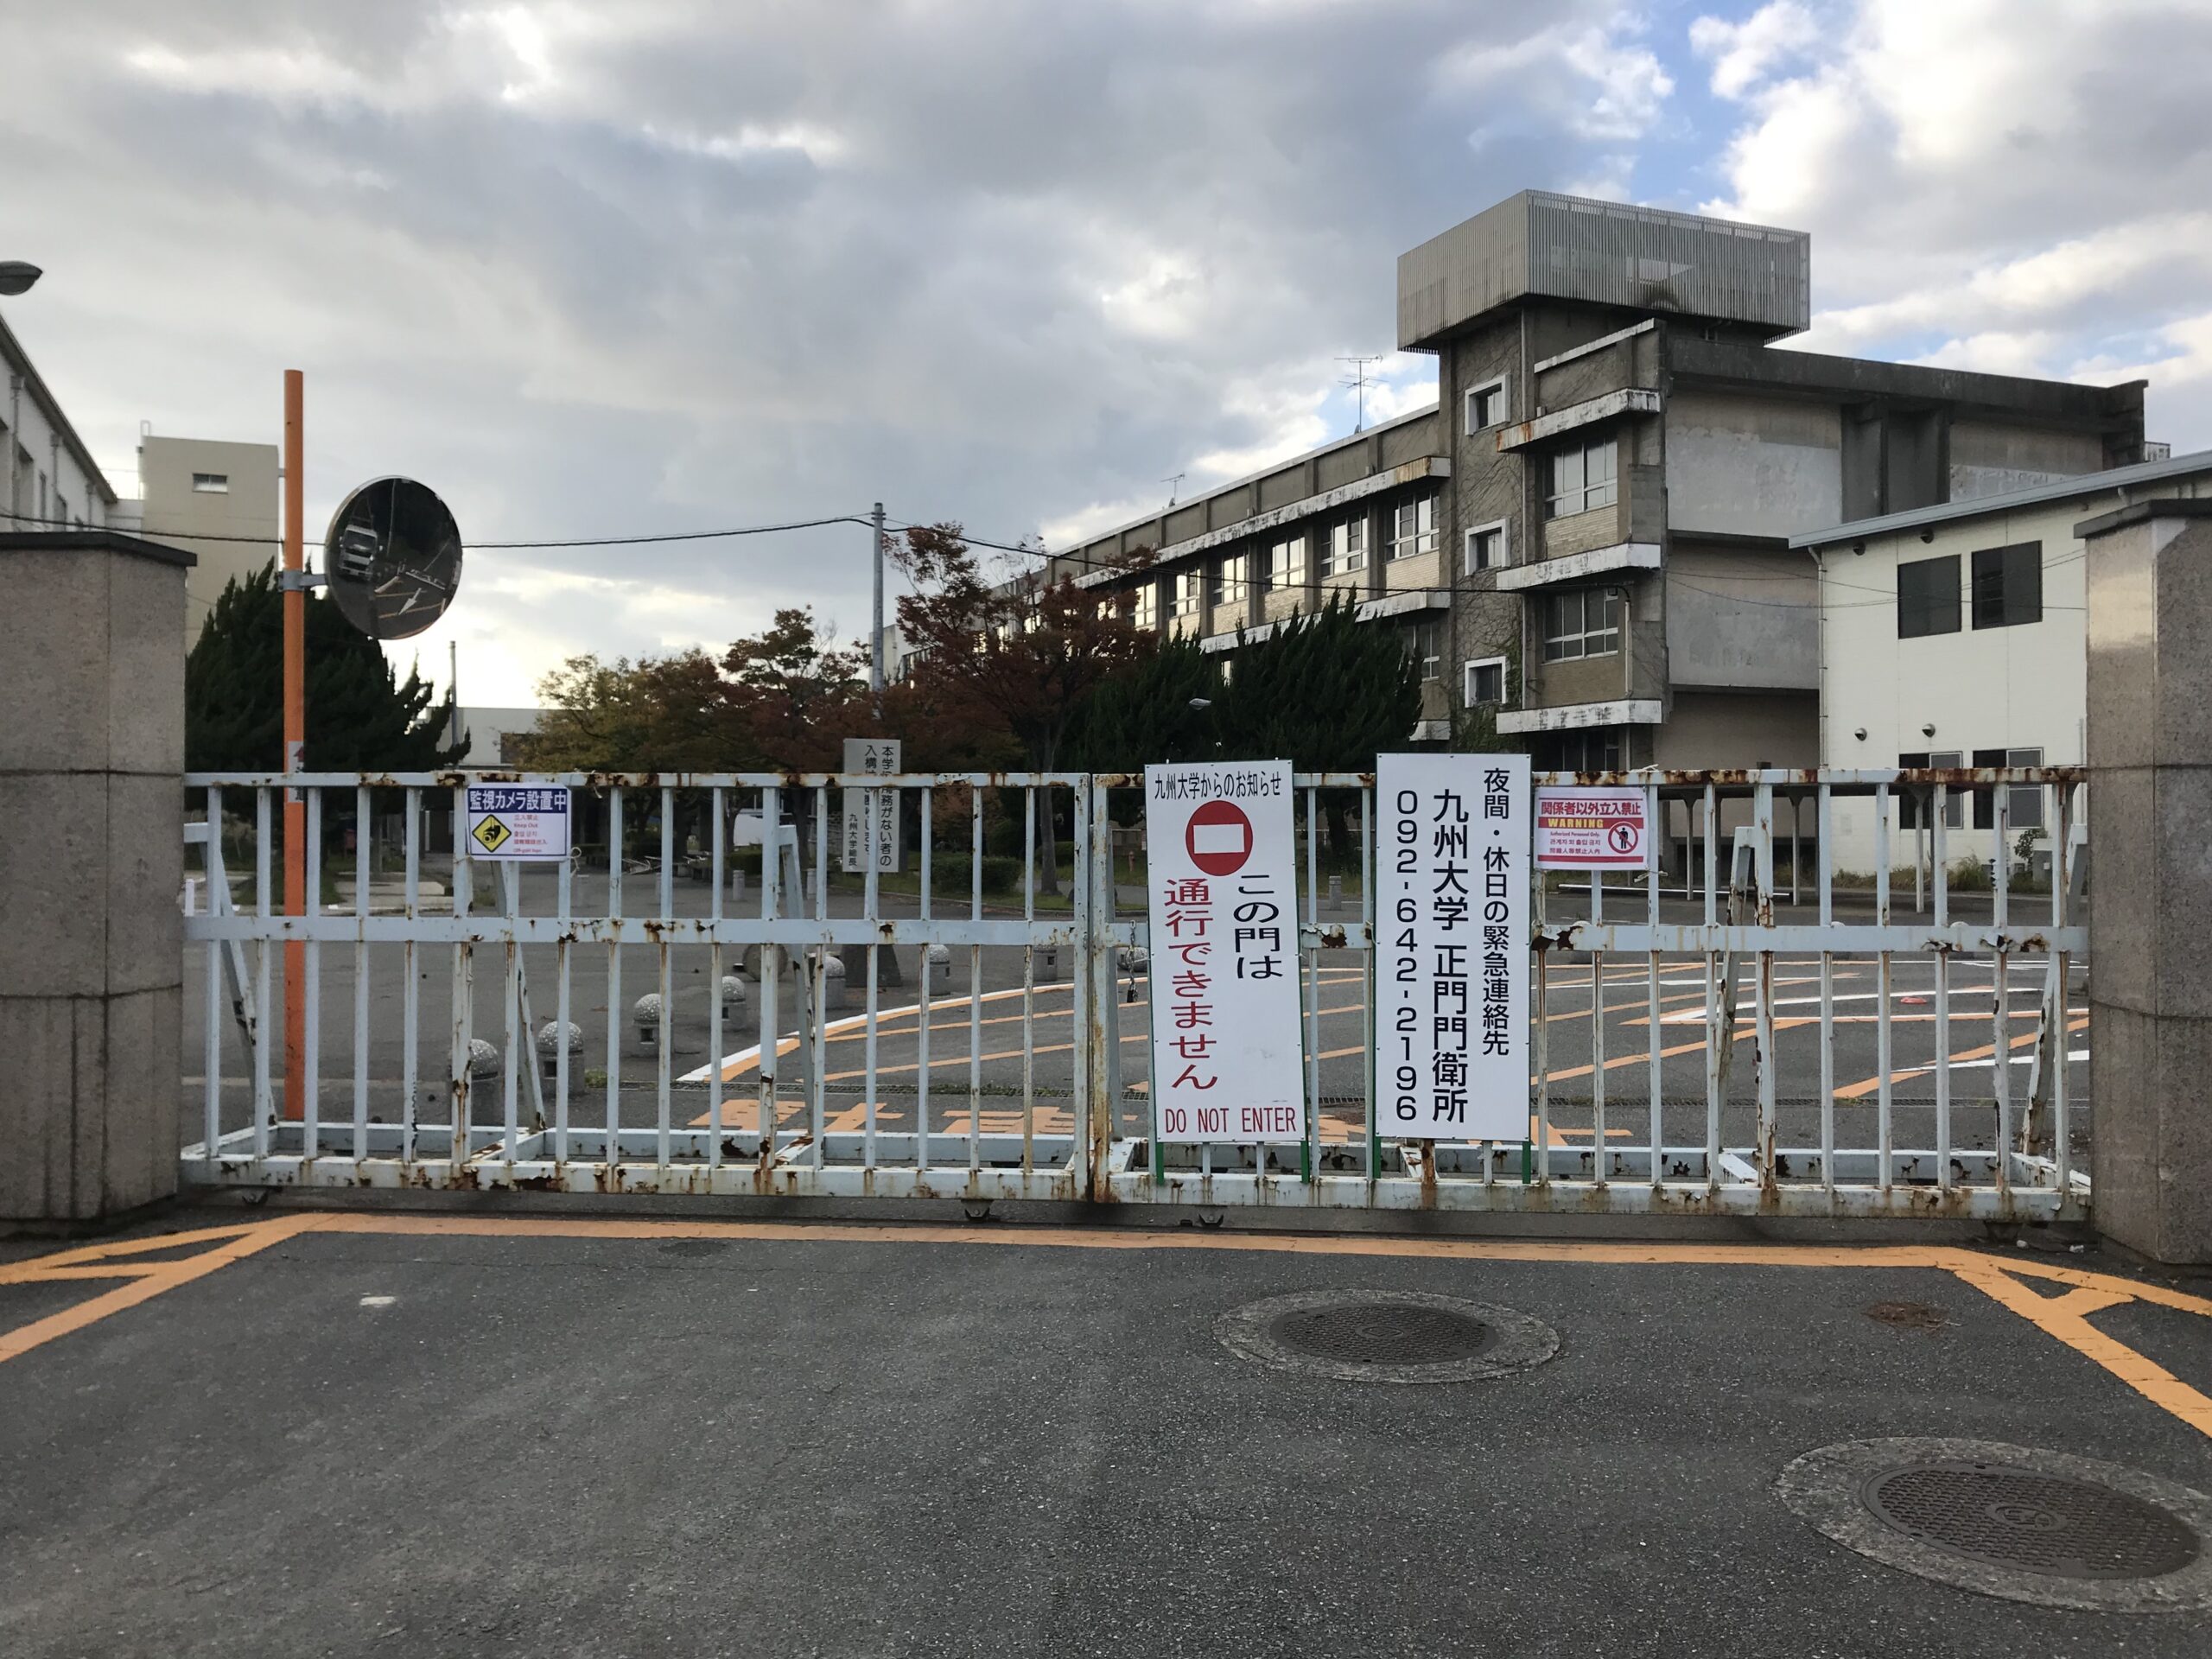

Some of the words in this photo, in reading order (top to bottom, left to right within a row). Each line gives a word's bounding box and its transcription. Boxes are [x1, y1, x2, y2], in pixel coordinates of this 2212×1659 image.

[469, 790, 567, 810] 監視カメラ設置中
[1154, 772, 1282, 800] 九州大学からのお知らせ
[1541, 801, 1642, 816] 関係者以外立入禁止
[1548, 817, 1604, 828] WARNING
[1483, 767, 1510, 1056] 夜間・休日の緊急連絡先
[1232, 874, 1283, 980] この門は
[1395, 790, 1418, 1121] 092-642-2196
[1163, 877, 1220, 1090] 通行できません
[1165, 1108, 1187, 1134] DO
[1198, 1107, 1230, 1134] NOT
[1241, 1106, 1297, 1133] ENTER
